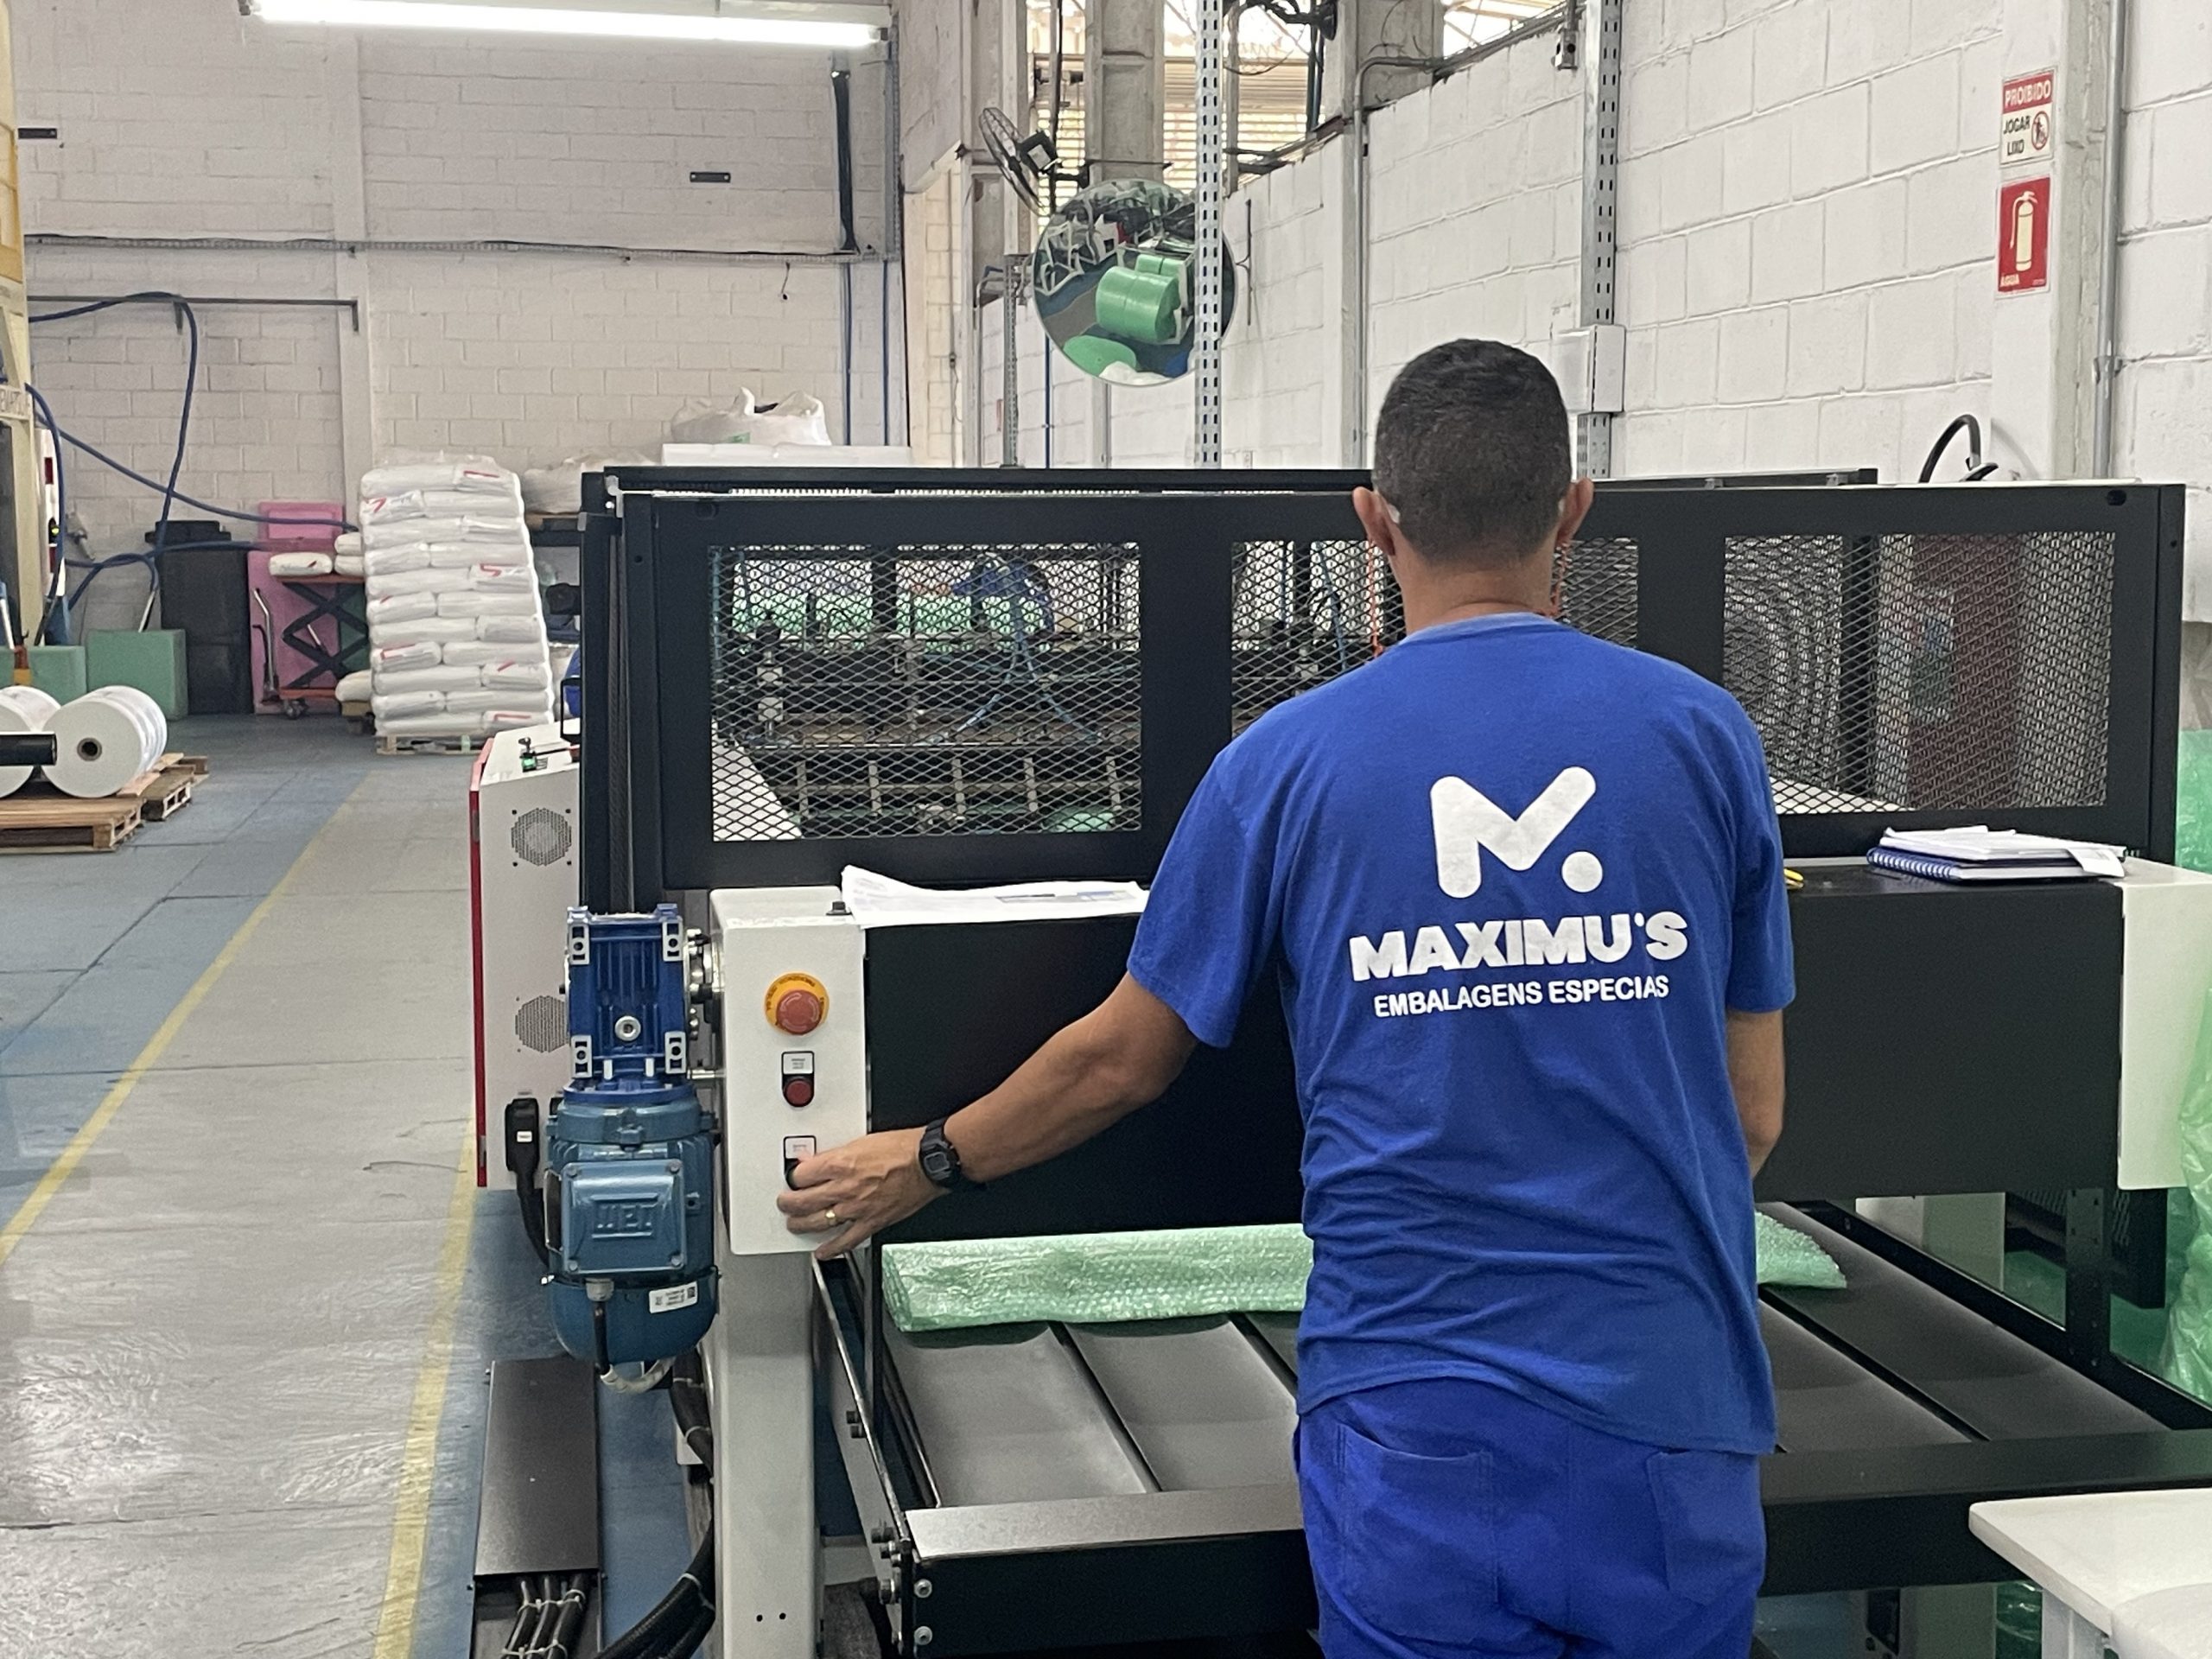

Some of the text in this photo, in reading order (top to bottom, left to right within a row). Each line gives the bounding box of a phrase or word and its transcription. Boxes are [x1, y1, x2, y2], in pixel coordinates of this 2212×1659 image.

[2005, 79, 2051, 108] PROIBIDO
[2004, 115, 2031, 135] JOGAR
[2007, 139, 2024, 156] LIXO
[1349, 912, 1688, 982] MAXIMU'S
[1374, 975, 1669, 1018] EMBALAGENS ESPECIAS
